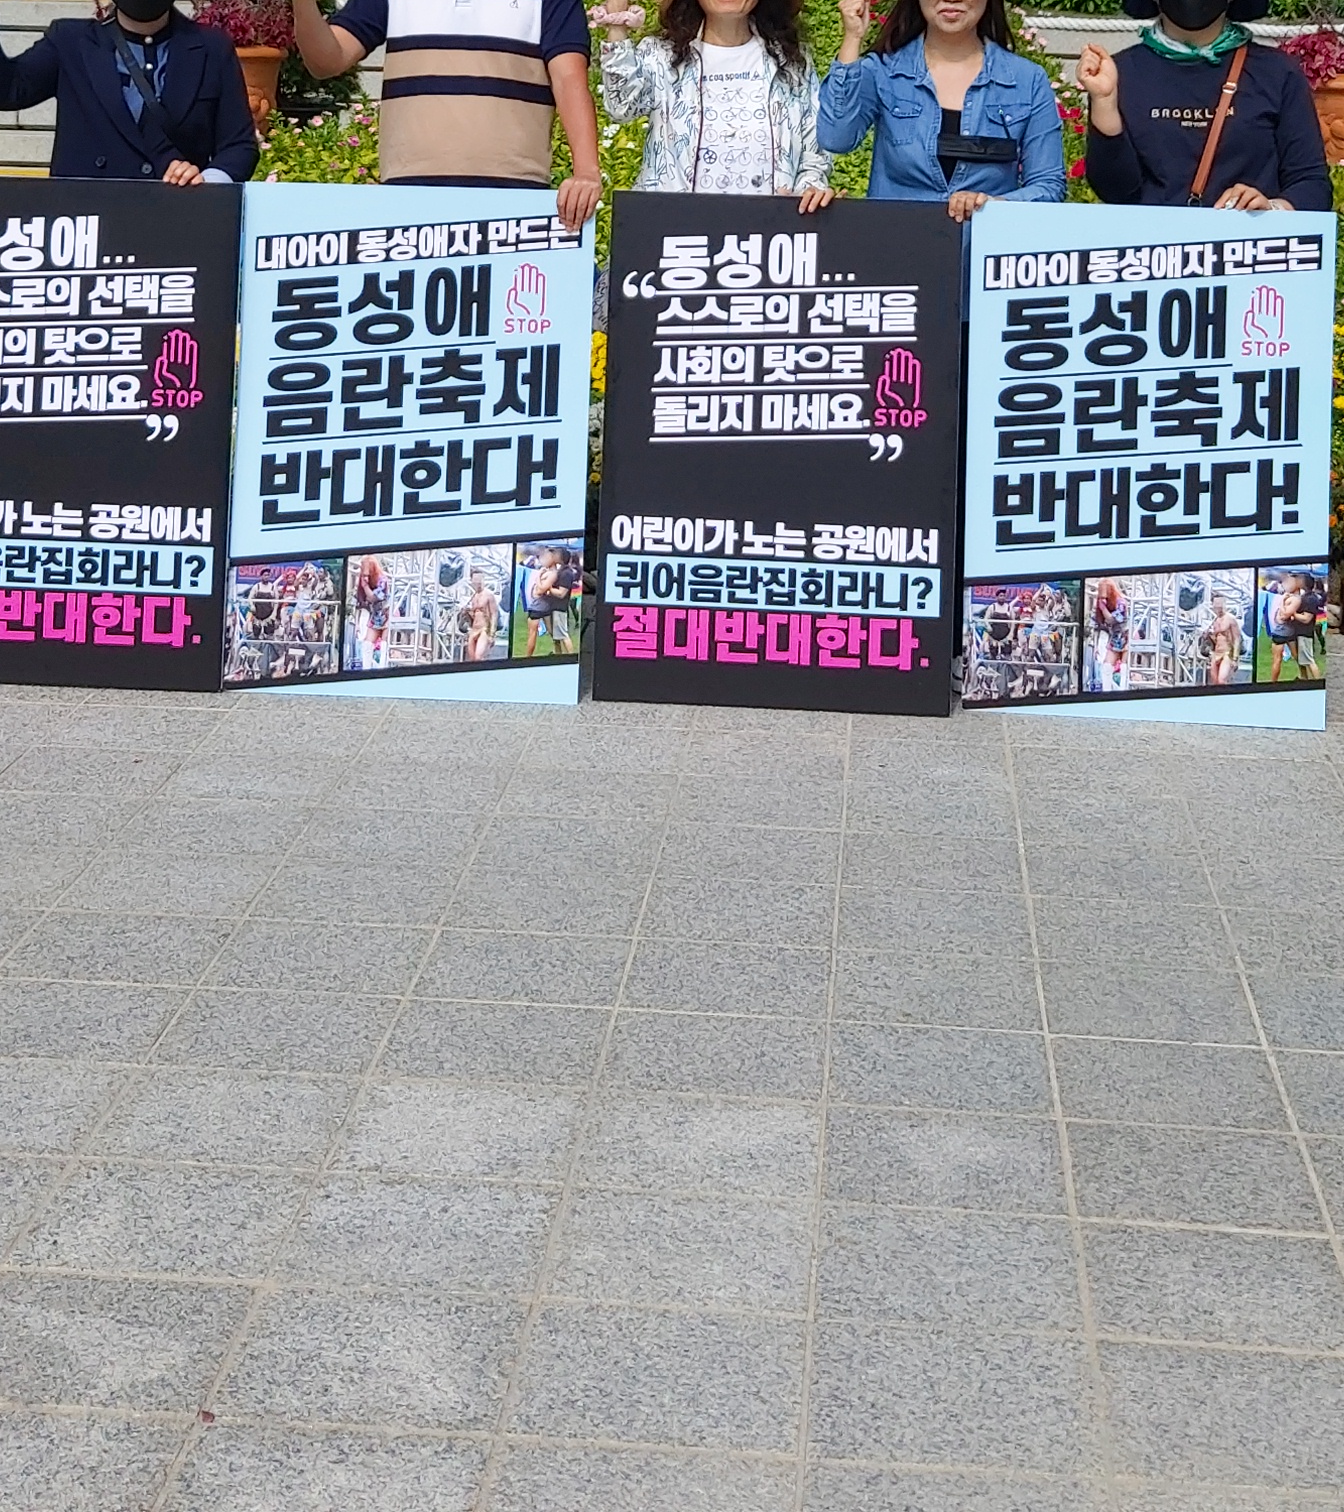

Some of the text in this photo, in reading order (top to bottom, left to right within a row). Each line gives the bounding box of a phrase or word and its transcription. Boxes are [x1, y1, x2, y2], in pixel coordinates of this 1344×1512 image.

[1151, 106, 1234, 120] BROOKLN
[257, 216, 580, 269] 내아이 동성애자 만드는
[985, 236, 1321, 289] 내아이 동성애자 만드는
[88, 273, 196, 316] 선택을
[271, 263, 492, 352] 동성애
[656, 291, 917, 335] 스스로의 선택을
[43, 325, 143, 363] 탓으로
[504, 317, 551, 335] STOP
[1001, 285, 1228, 371] 동성애
[654, 344, 864, 385] 사회의 탓으로
[1241, 340, 1290, 357] STOP
[41, 374, 148, 413] 마세요.
[151, 389, 204, 409] STOP
[263, 344, 561, 439] 음란축제
[653, 393, 870, 434] 돌리지 마세요.
[994, 367, 1301, 458] 음란축제
[874, 407, 928, 428] STOP
[259, 434, 558, 525] 반대한다!
[21, 502, 84, 537] 노는
[89, 503, 213, 543] 공원에서
[993, 458, 1300, 546] 반대한다!
[611, 514, 939, 564] 어린이가 노는 공원에서
[614, 560, 933, 611] 퀴어음란집회라니?
[612, 606, 929, 671] 절대반대한다.
